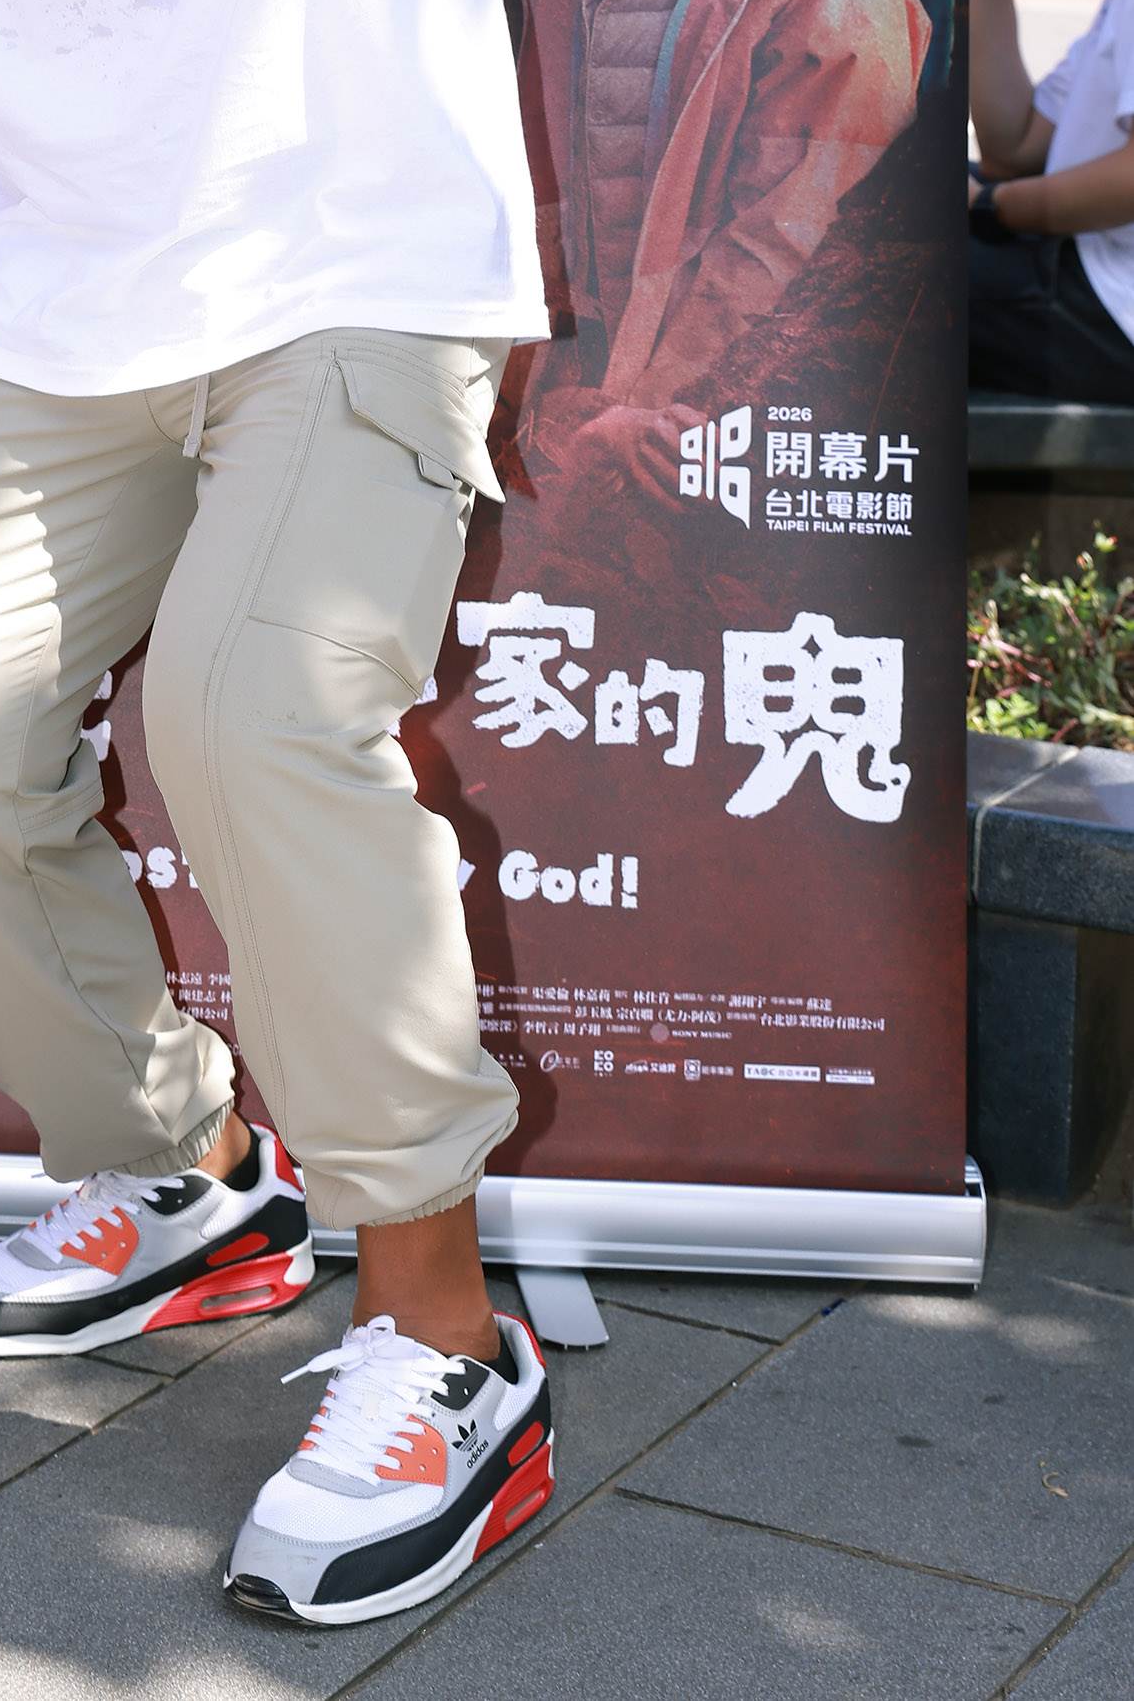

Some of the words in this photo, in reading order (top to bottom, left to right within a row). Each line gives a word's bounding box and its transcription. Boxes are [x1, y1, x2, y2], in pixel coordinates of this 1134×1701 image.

[767, 405, 813, 422] 2026
[766, 430, 920, 484] 開幕片
[765, 488, 913, 522] 台北電影節
[766, 519, 809, 532] TAIPEI
[813, 520, 845, 534] FILM
[849, 522, 913, 536] FESTIVAL
[498, 849, 639, 909] God!
[466, 1439, 489, 1469] adidas
